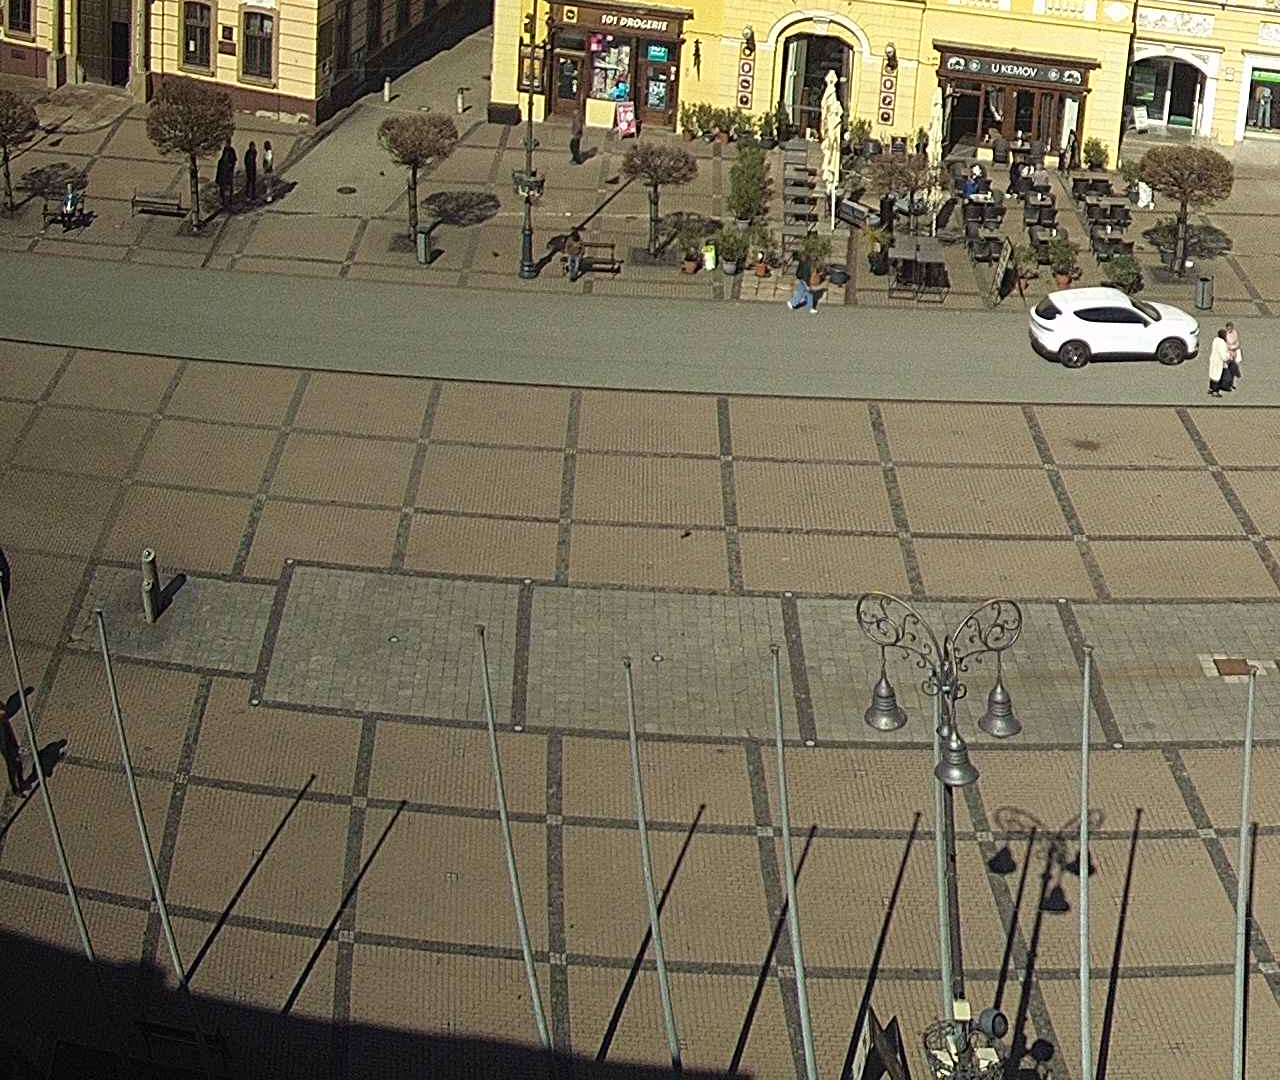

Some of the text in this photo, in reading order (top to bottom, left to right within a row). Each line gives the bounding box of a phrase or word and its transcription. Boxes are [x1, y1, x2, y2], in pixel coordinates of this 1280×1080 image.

[601, 14, 668, 31] 101 DROGERIE
[991, 63, 1038, 78] U KEMOV
